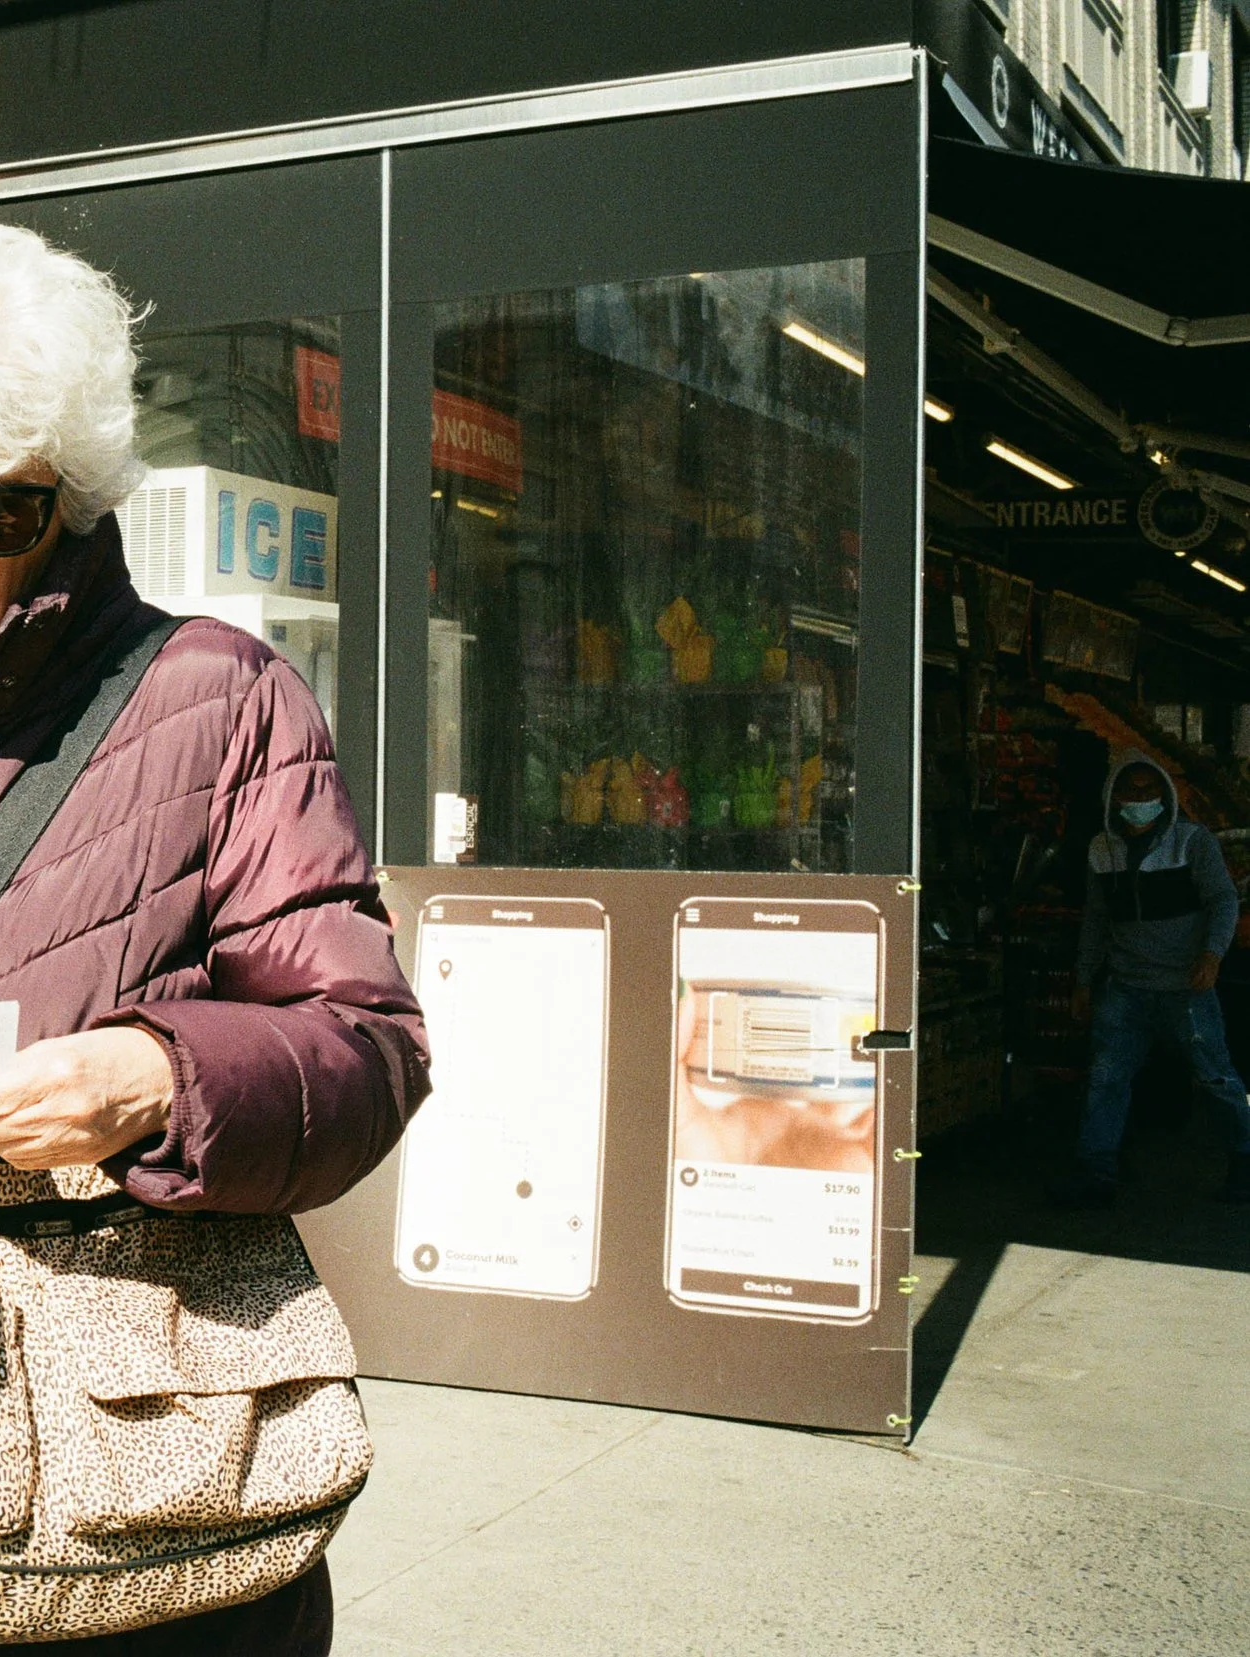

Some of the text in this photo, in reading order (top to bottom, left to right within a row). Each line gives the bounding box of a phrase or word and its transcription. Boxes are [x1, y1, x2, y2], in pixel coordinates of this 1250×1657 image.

[442, 415, 479, 452] NOT
[217, 489, 327, 590] ICE
[492, 909, 533, 921] Shopping
[753, 912, 800, 924] Shopping
[824, 1182, 860, 1195] $17.90
[445, 1249, 519, 1265] Coconut Milk
